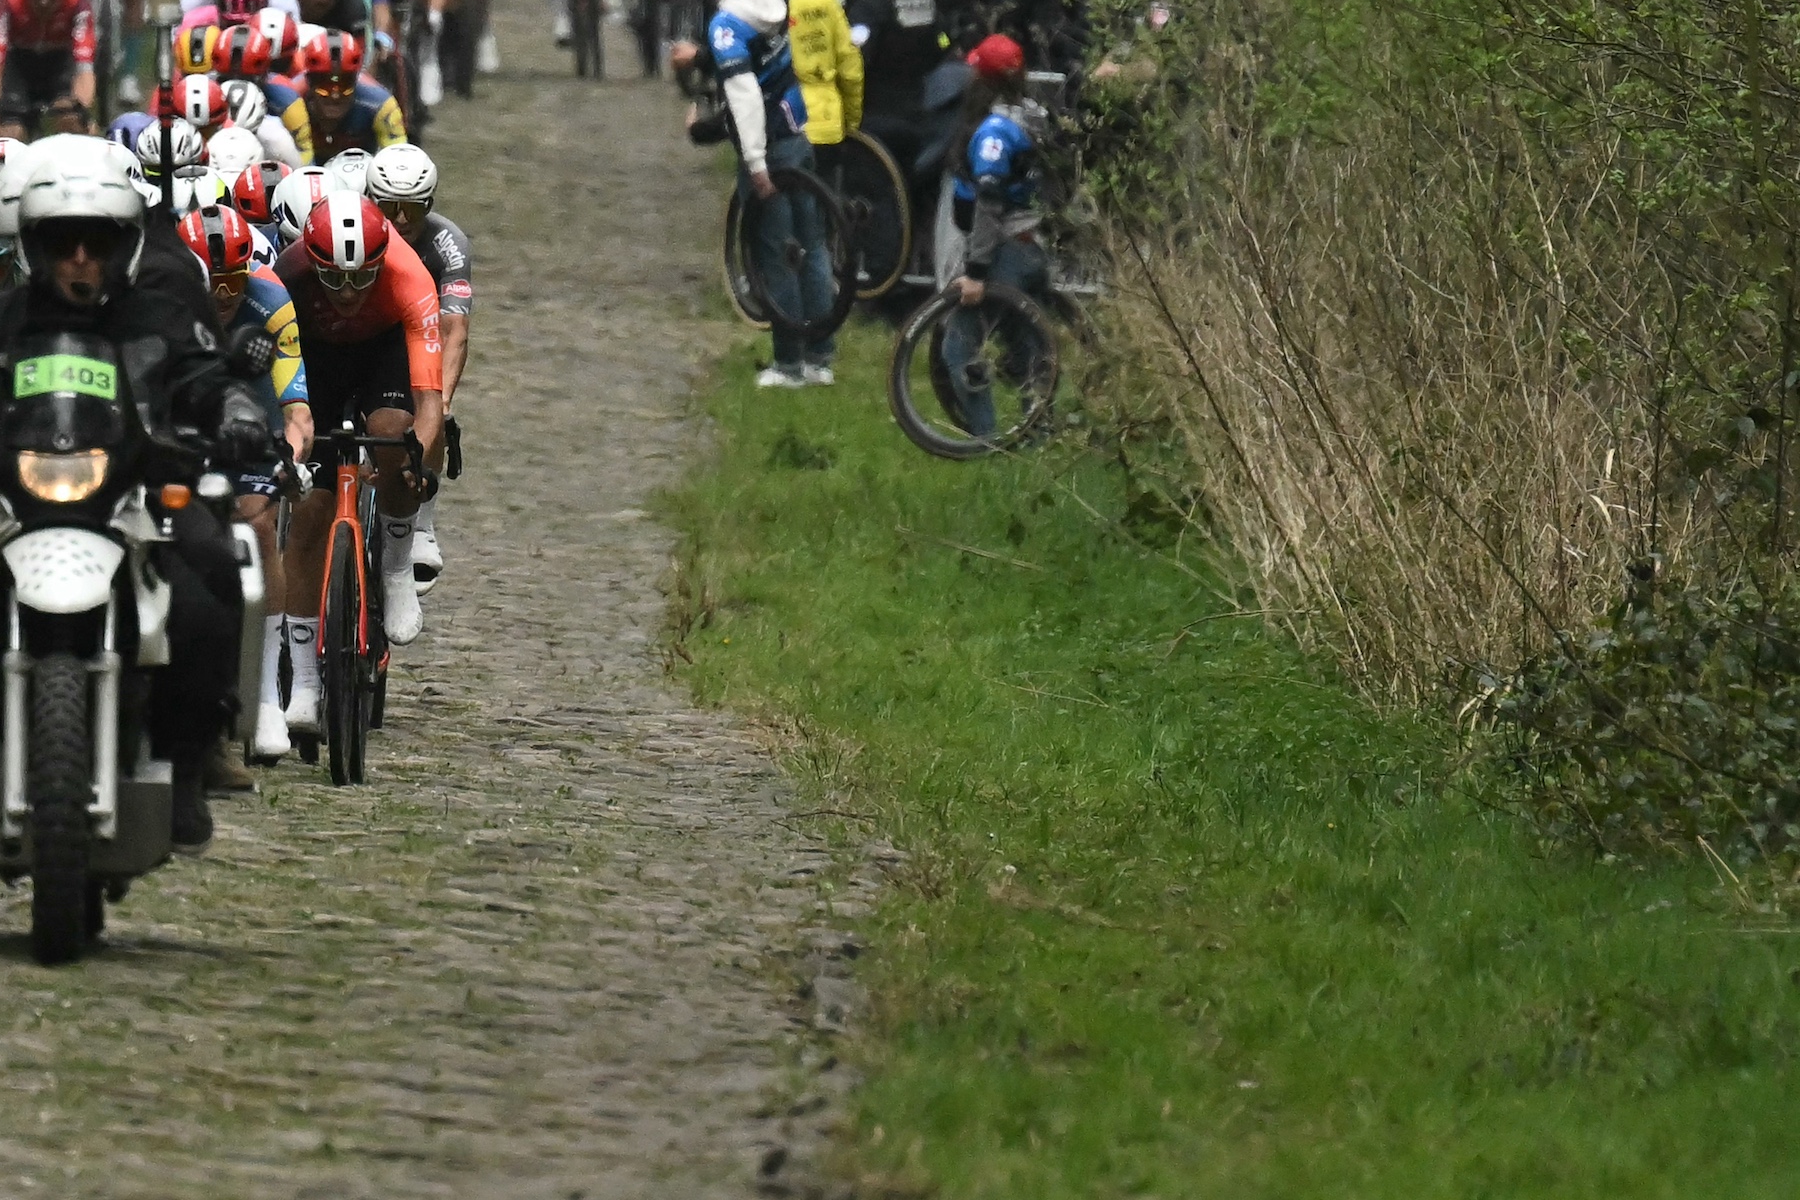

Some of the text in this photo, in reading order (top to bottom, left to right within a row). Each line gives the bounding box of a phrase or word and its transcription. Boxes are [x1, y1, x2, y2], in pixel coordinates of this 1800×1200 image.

[433, 228, 466, 271] Alpecin
[417, 291, 443, 355] INEOS
[60, 366, 111, 391] 403
